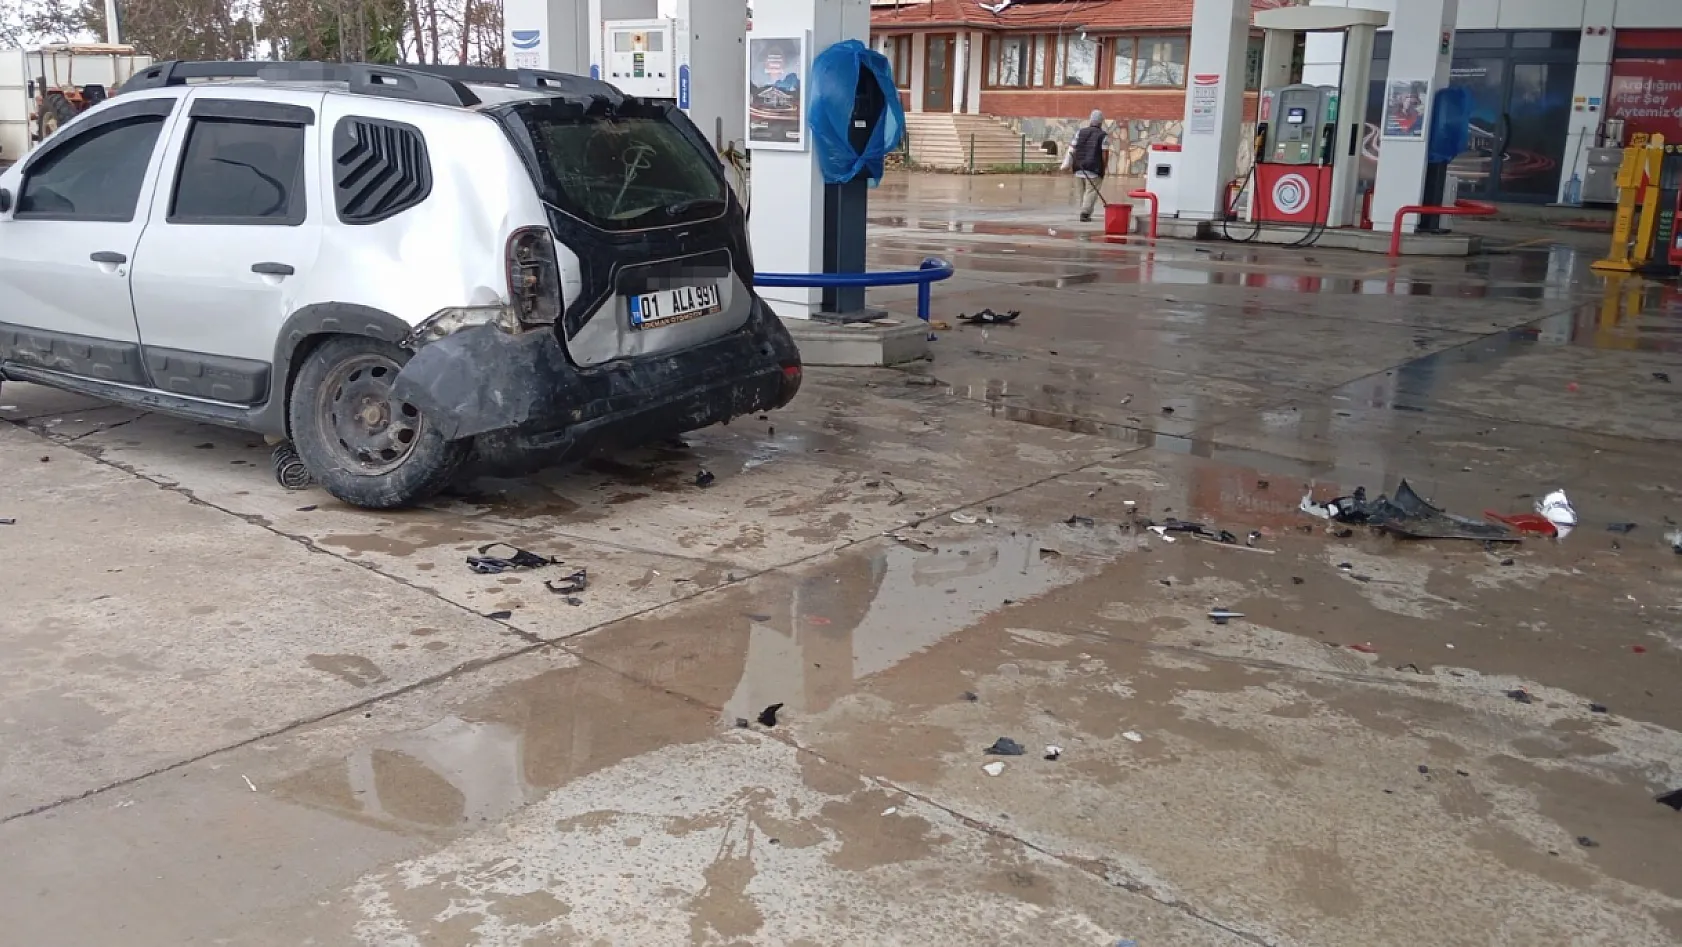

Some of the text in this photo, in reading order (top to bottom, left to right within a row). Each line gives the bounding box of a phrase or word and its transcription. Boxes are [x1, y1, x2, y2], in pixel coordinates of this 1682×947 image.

[1617, 93, 1668, 106] Her Şey
[641, 285, 716, 318] 01 ALA 991
